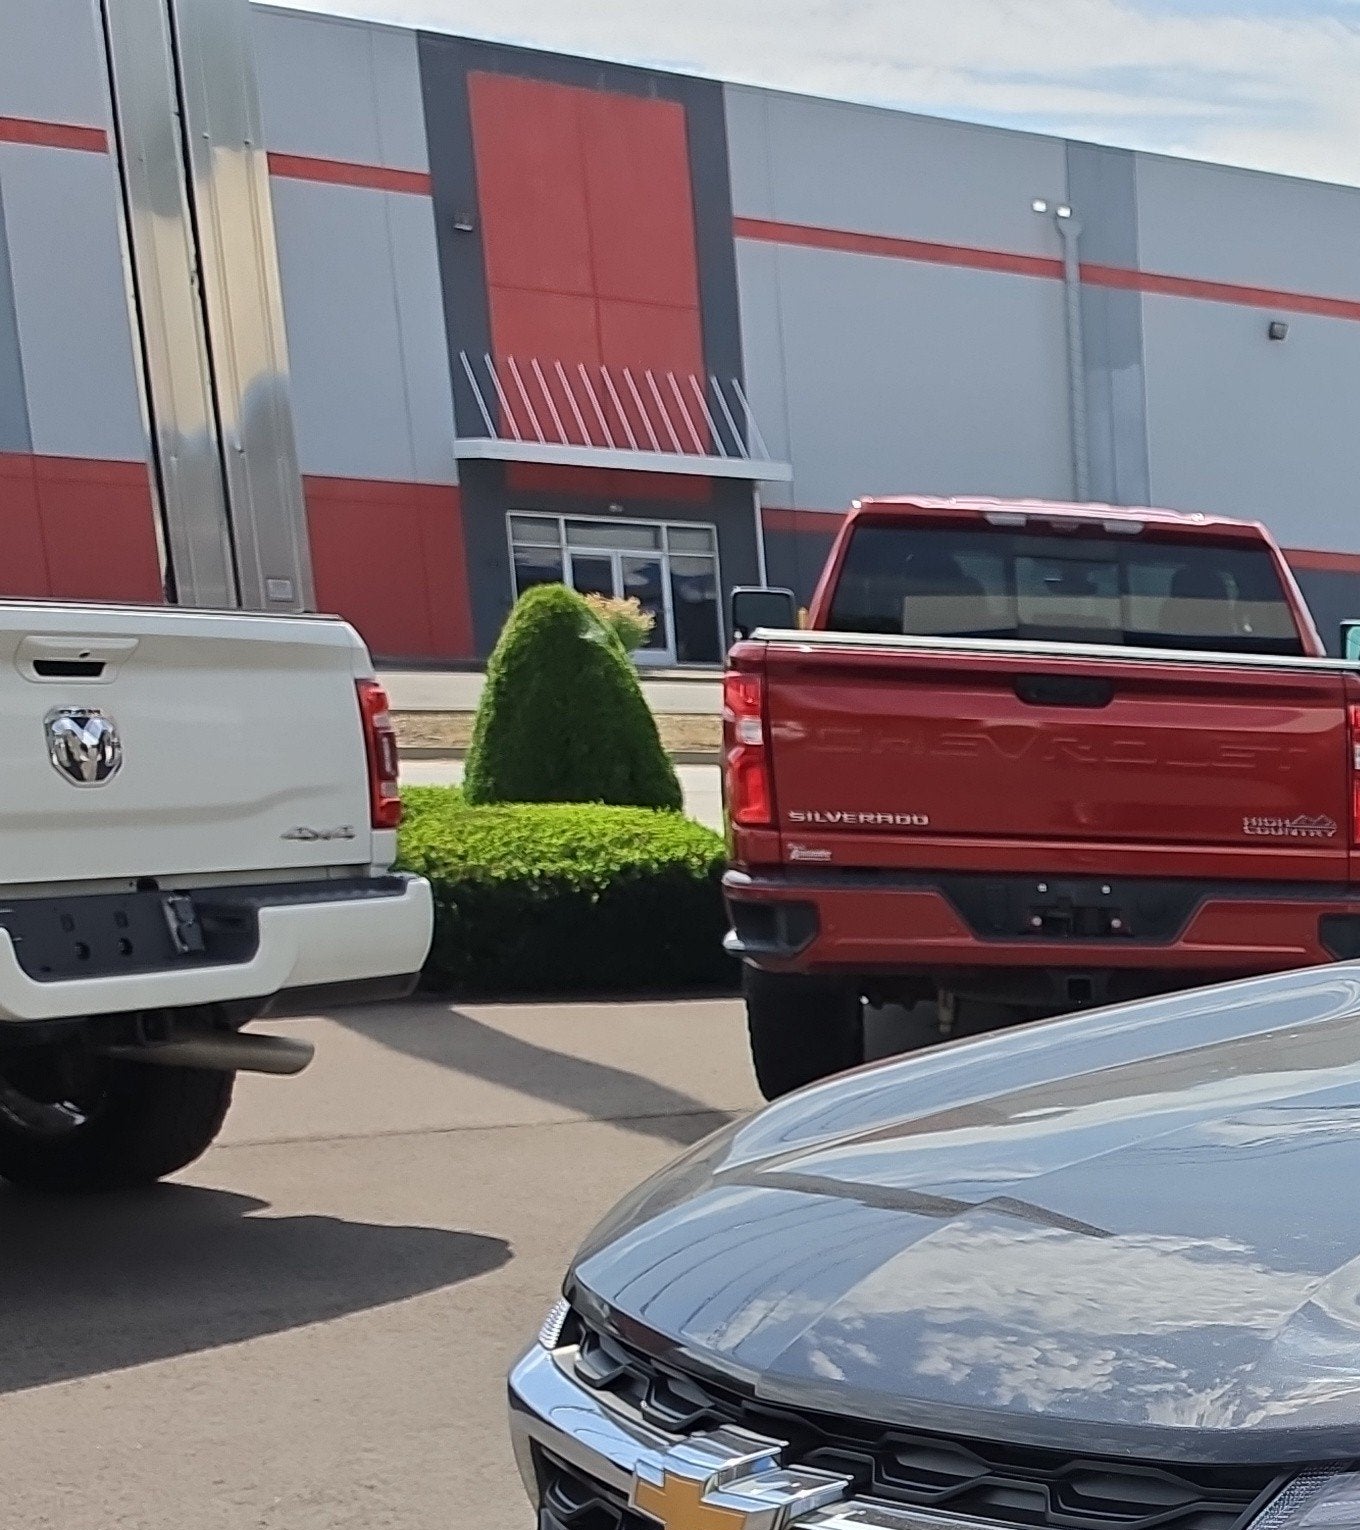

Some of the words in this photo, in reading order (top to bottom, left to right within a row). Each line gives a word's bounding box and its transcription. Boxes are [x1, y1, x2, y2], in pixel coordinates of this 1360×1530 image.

[787, 810, 930, 826] SILVERADO
[1242, 816, 1291, 827] HIGH
[1242, 826, 1337, 837] COUNTRY
